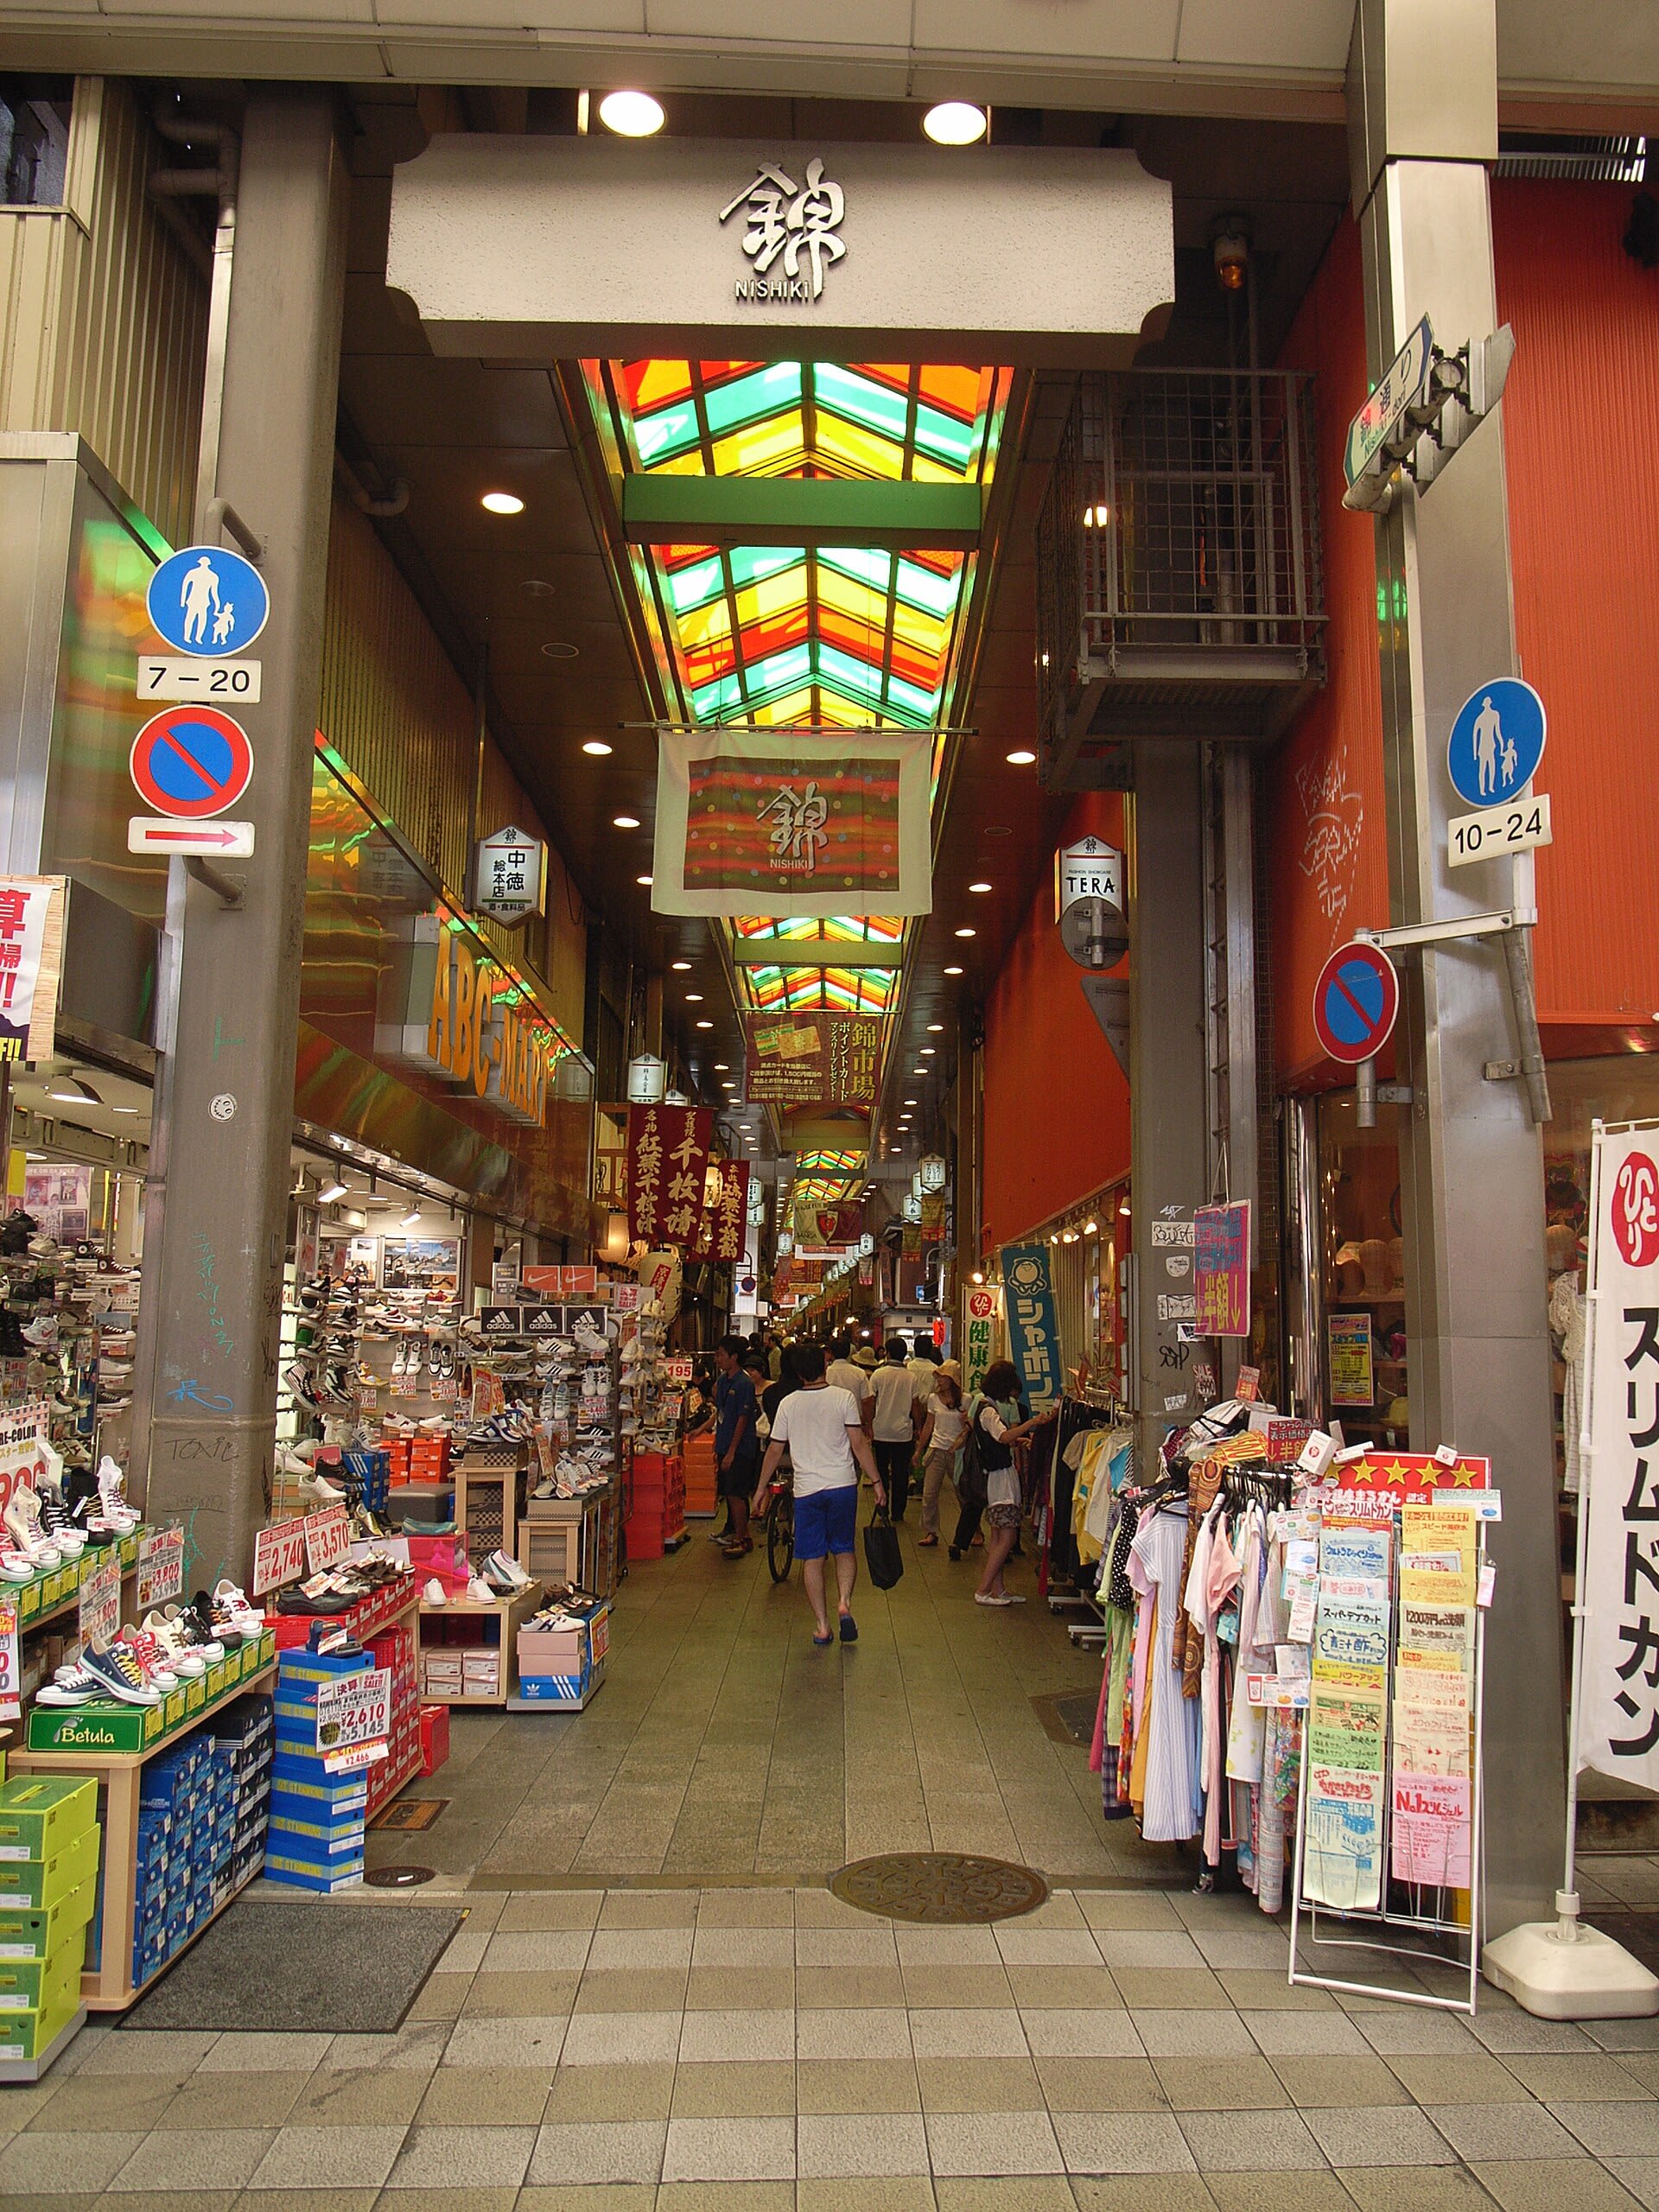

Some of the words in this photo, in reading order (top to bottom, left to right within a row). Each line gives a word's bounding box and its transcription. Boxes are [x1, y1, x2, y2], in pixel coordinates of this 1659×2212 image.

[718, 156, 848, 302] 錦
[734, 278, 810, 302] NISHIKI
[756, 780, 829, 872] 錦
[1454, 807, 1542, 855] 10-24
[505, 849, 526, 891] 中徳
[769, 858, 809, 870] NISHIKI
[1065, 876, 1116, 896] TERA
[838, 1021, 851, 1102] ポイントカード
[850, 1021, 877, 1102] 錦市場
[663, 1136, 704, 1237] 千枚漬
[1204, 1273, 1230, 1331] 半額
[486, 1321, 515, 1331] adidas
[528, 1321, 557, 1331] adidas
[667, 1365, 692, 1377] 195
[315, 1522, 350, 1565] ¥3,570
[1608, 1306, 1659, 1744] スリムドカン
[264, 1537, 303, 1584] ¥2,740
[337, 1679, 359, 1696] 決算
[1338, 1672, 1381, 1681] パワーアップ
[60, 1727, 116, 1745] Betula
